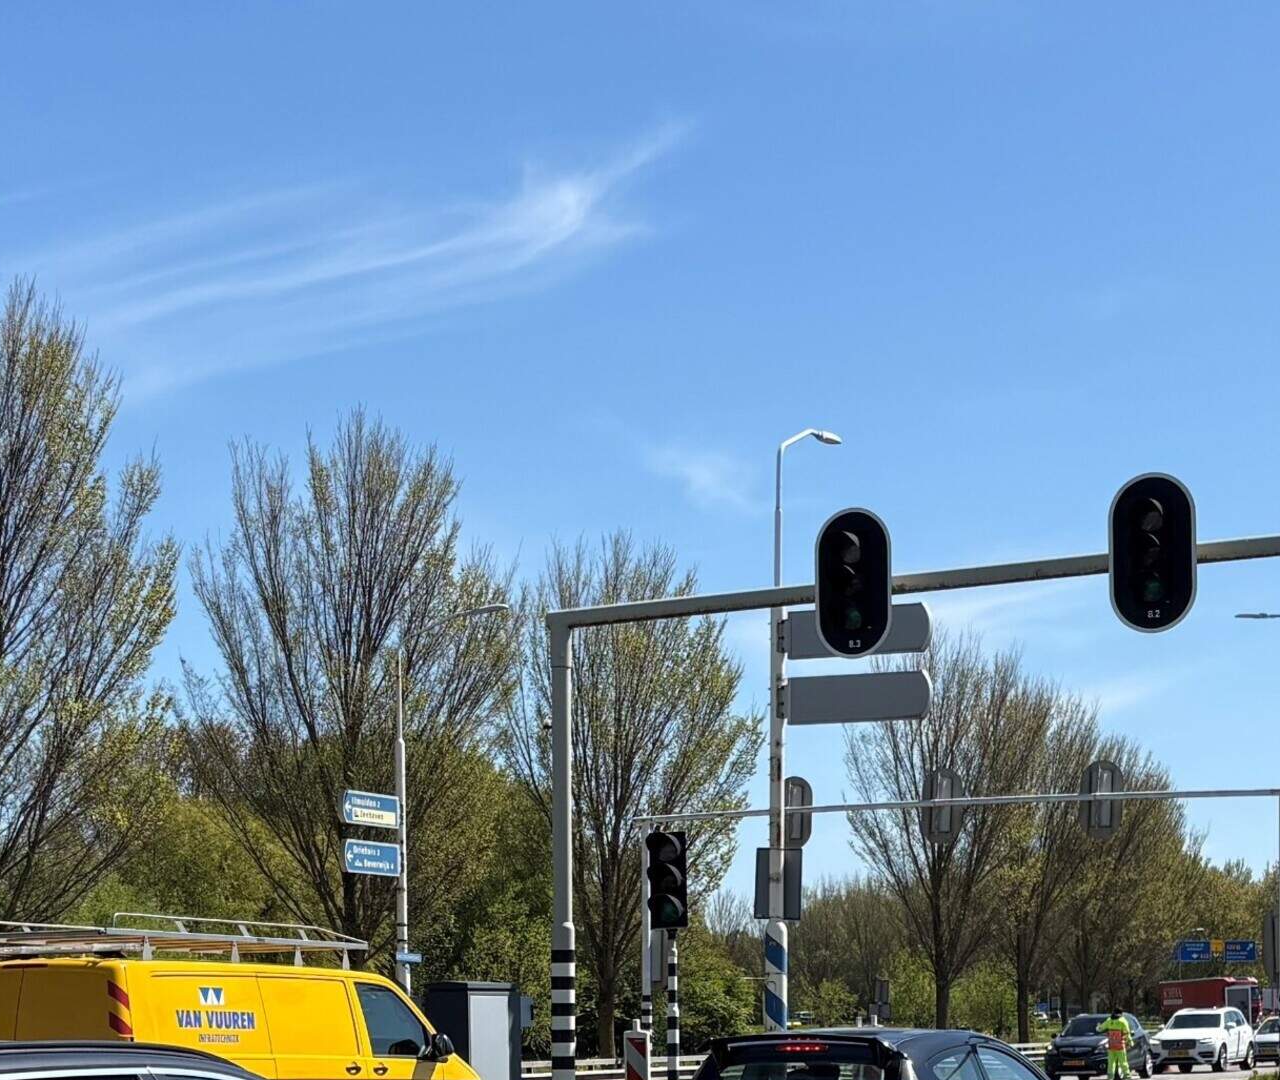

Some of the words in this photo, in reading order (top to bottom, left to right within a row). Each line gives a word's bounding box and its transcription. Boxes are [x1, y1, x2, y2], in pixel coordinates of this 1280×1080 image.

[1147, 609, 1161, 618] 8.2
[176, 1009, 202, 1028] VAN
[206, 1010, 256, 1030] VUUREN
